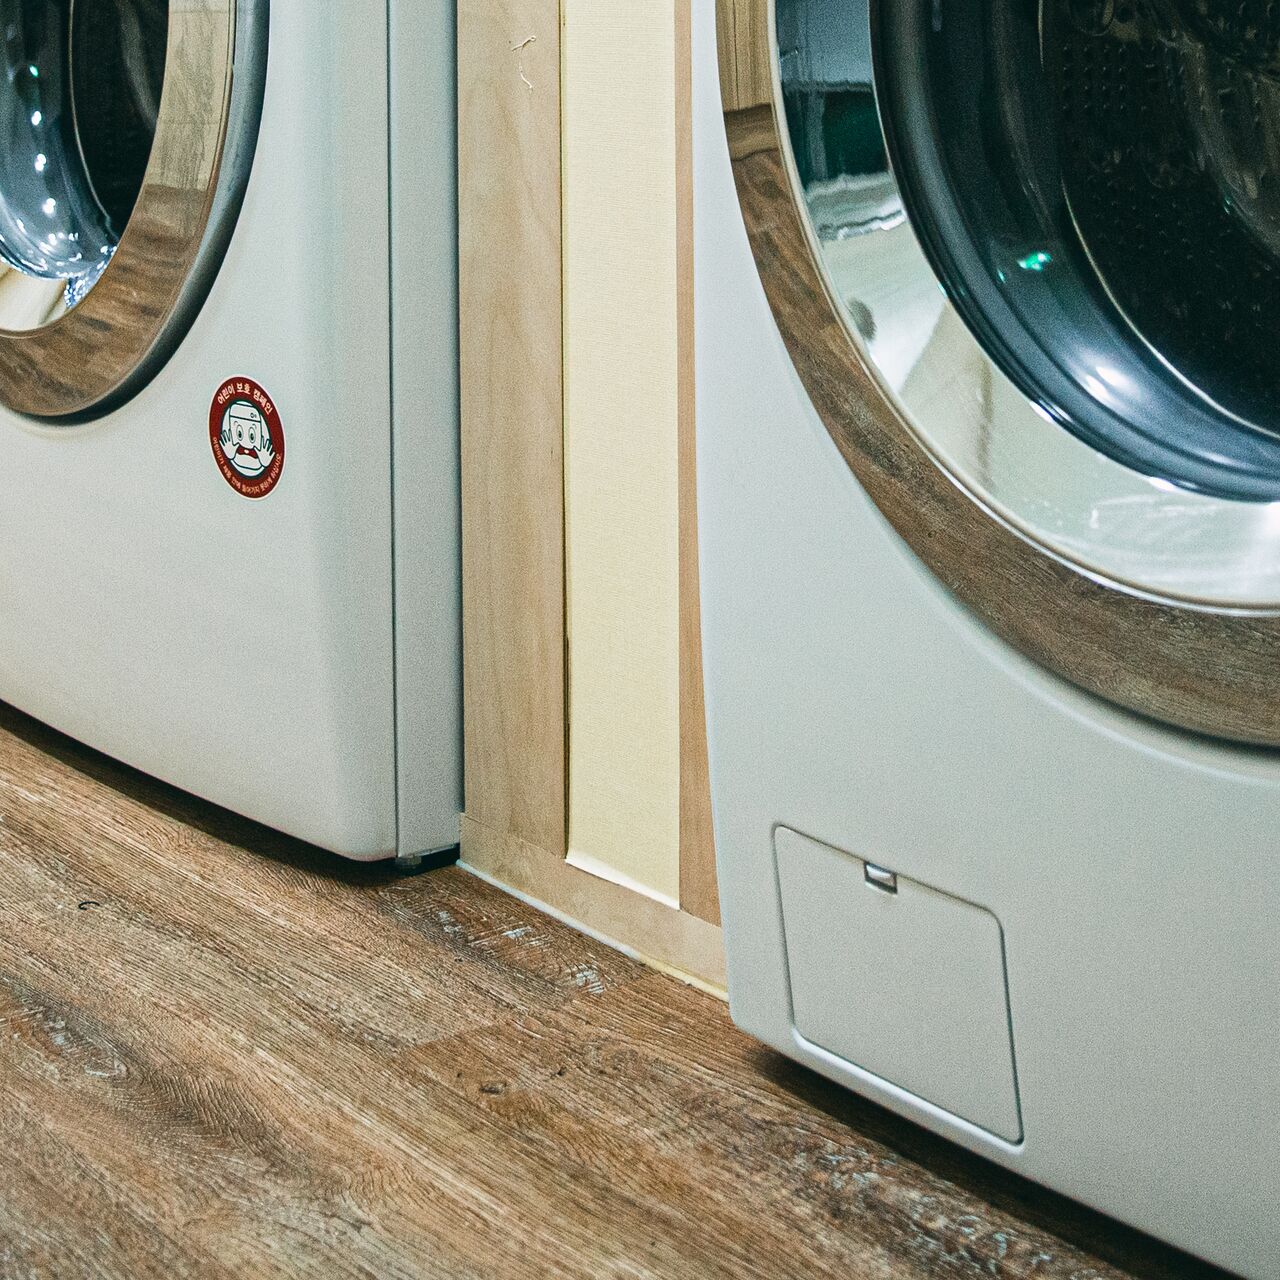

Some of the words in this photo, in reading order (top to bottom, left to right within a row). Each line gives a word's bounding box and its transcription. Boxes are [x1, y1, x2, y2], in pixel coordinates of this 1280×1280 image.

[217, 383, 235, 404] 어린이
[236, 382, 251, 395] 보호
[253, 388, 273, 415] 캠페인
